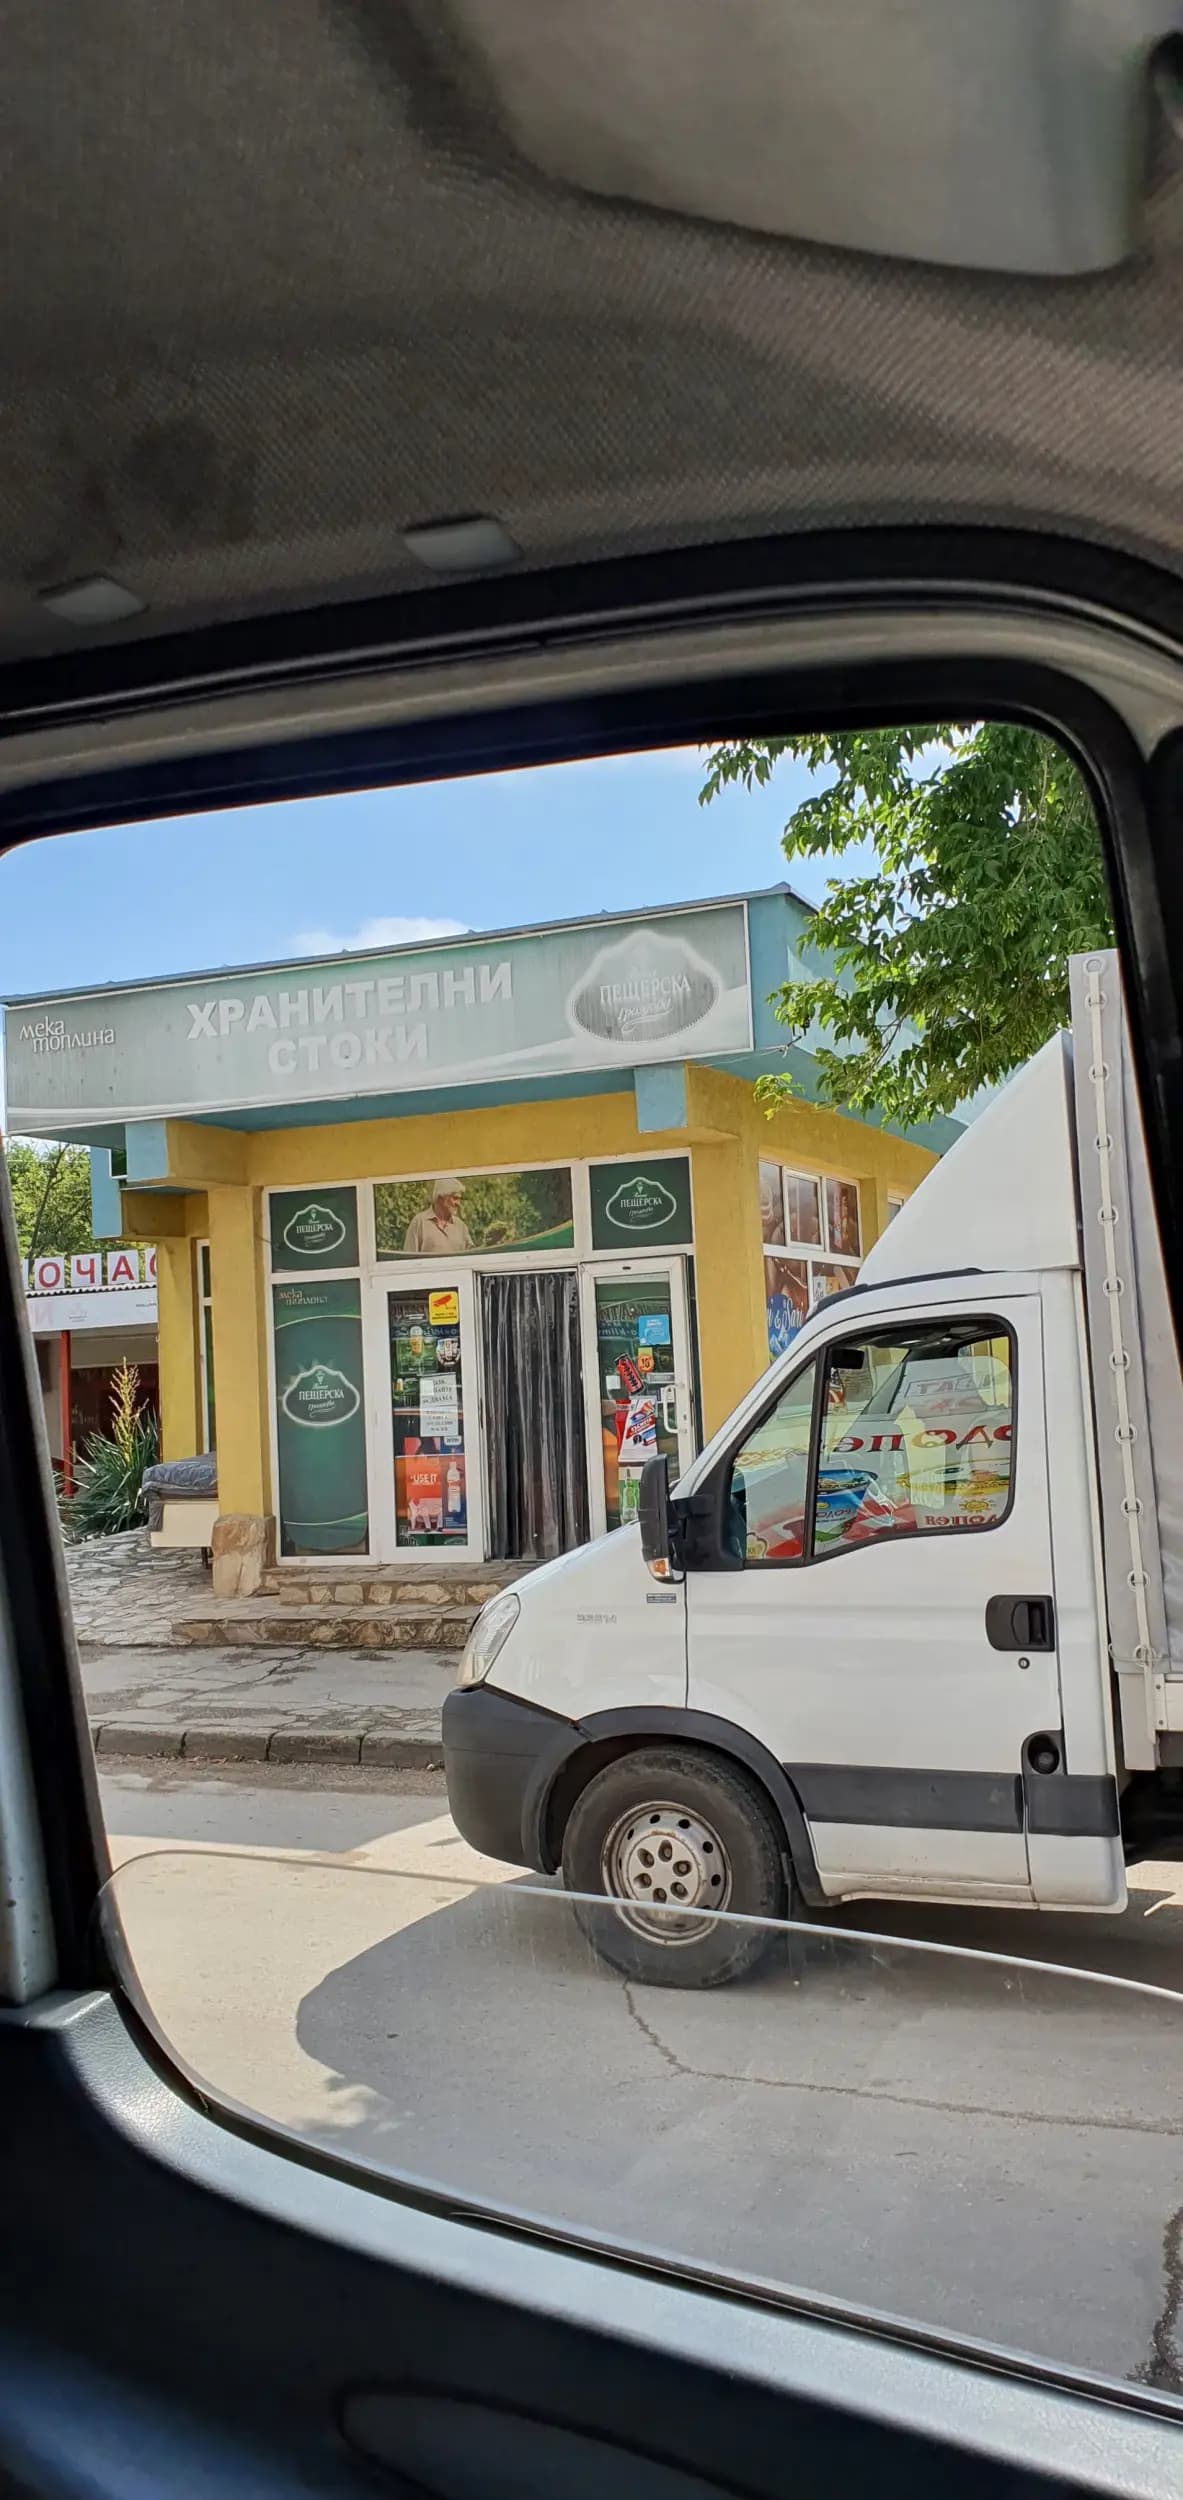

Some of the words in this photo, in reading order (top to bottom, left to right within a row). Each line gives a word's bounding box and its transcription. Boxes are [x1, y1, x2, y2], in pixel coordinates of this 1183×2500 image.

[187, 961, 513, 1040] ХРАНИТЕЛНИ
[600, 974, 692, 1002] ПЕЩЕРСКА
[267, 1023, 428, 1075] СТОКИ
[299, 1388, 345, 1401] ПЕЩЕРСКА
